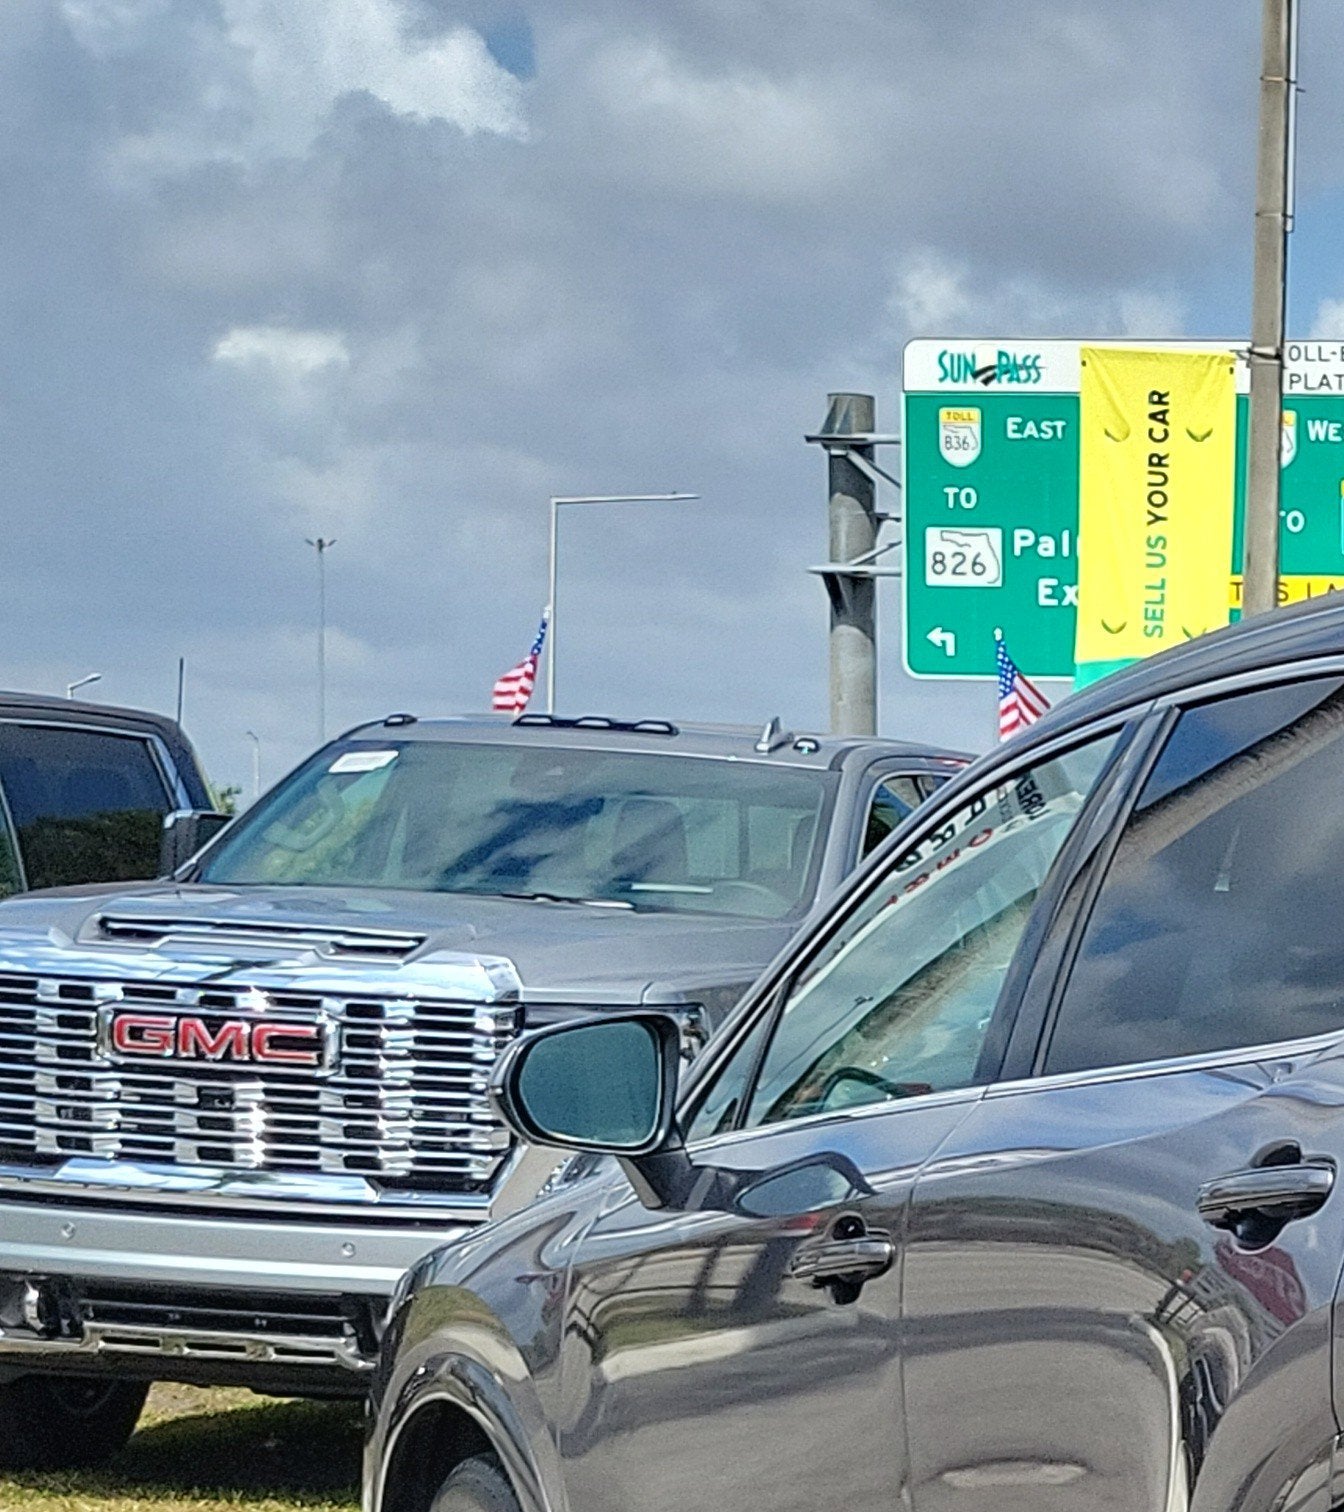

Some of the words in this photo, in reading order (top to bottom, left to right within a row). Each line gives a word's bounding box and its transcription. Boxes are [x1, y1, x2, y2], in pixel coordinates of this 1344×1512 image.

[946, 411, 974, 421] TOLL
[1006, 417, 1067, 440] EAST
[1148, 389, 1170, 443] CAR
[944, 435, 970, 451] 836
[943, 486, 978, 509] TO
[1146, 452, 1170, 526] YOUR
[1279, 509, 1305, 533] O
[1013, 528, 1080, 558] Pal
[1145, 535, 1168, 569] US
[931, 551, 986, 576] 826
[1143, 577, 1167, 638] SELL
[113, 1014, 320, 1066] GMC
